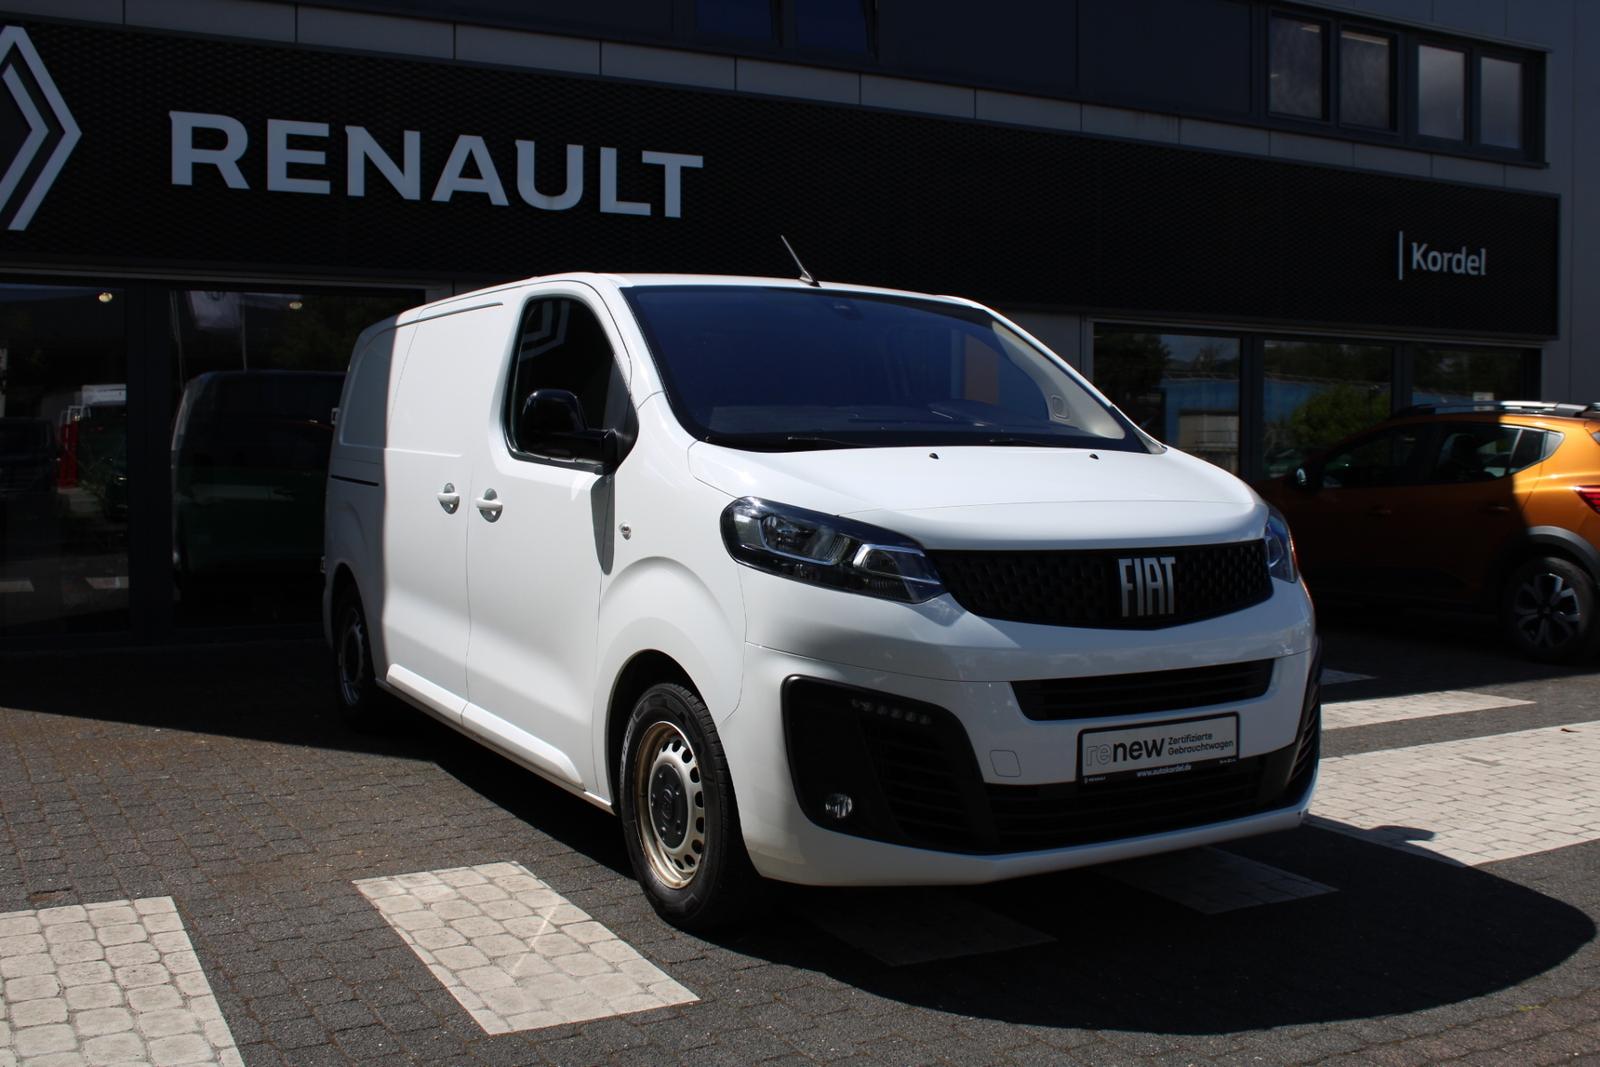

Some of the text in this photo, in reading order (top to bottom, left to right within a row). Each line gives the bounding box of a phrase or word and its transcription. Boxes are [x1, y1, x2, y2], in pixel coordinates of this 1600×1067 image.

[169, 110, 704, 219] RENAULT
[1411, 241, 1487, 276] Kordel
[1118, 556, 1176, 617] FIAT
[1086, 738, 1165, 766] renew
[1168, 733, 1213, 745] Zertifizierte
[1168, 740, 1234, 756] Gebrauchtwagen
